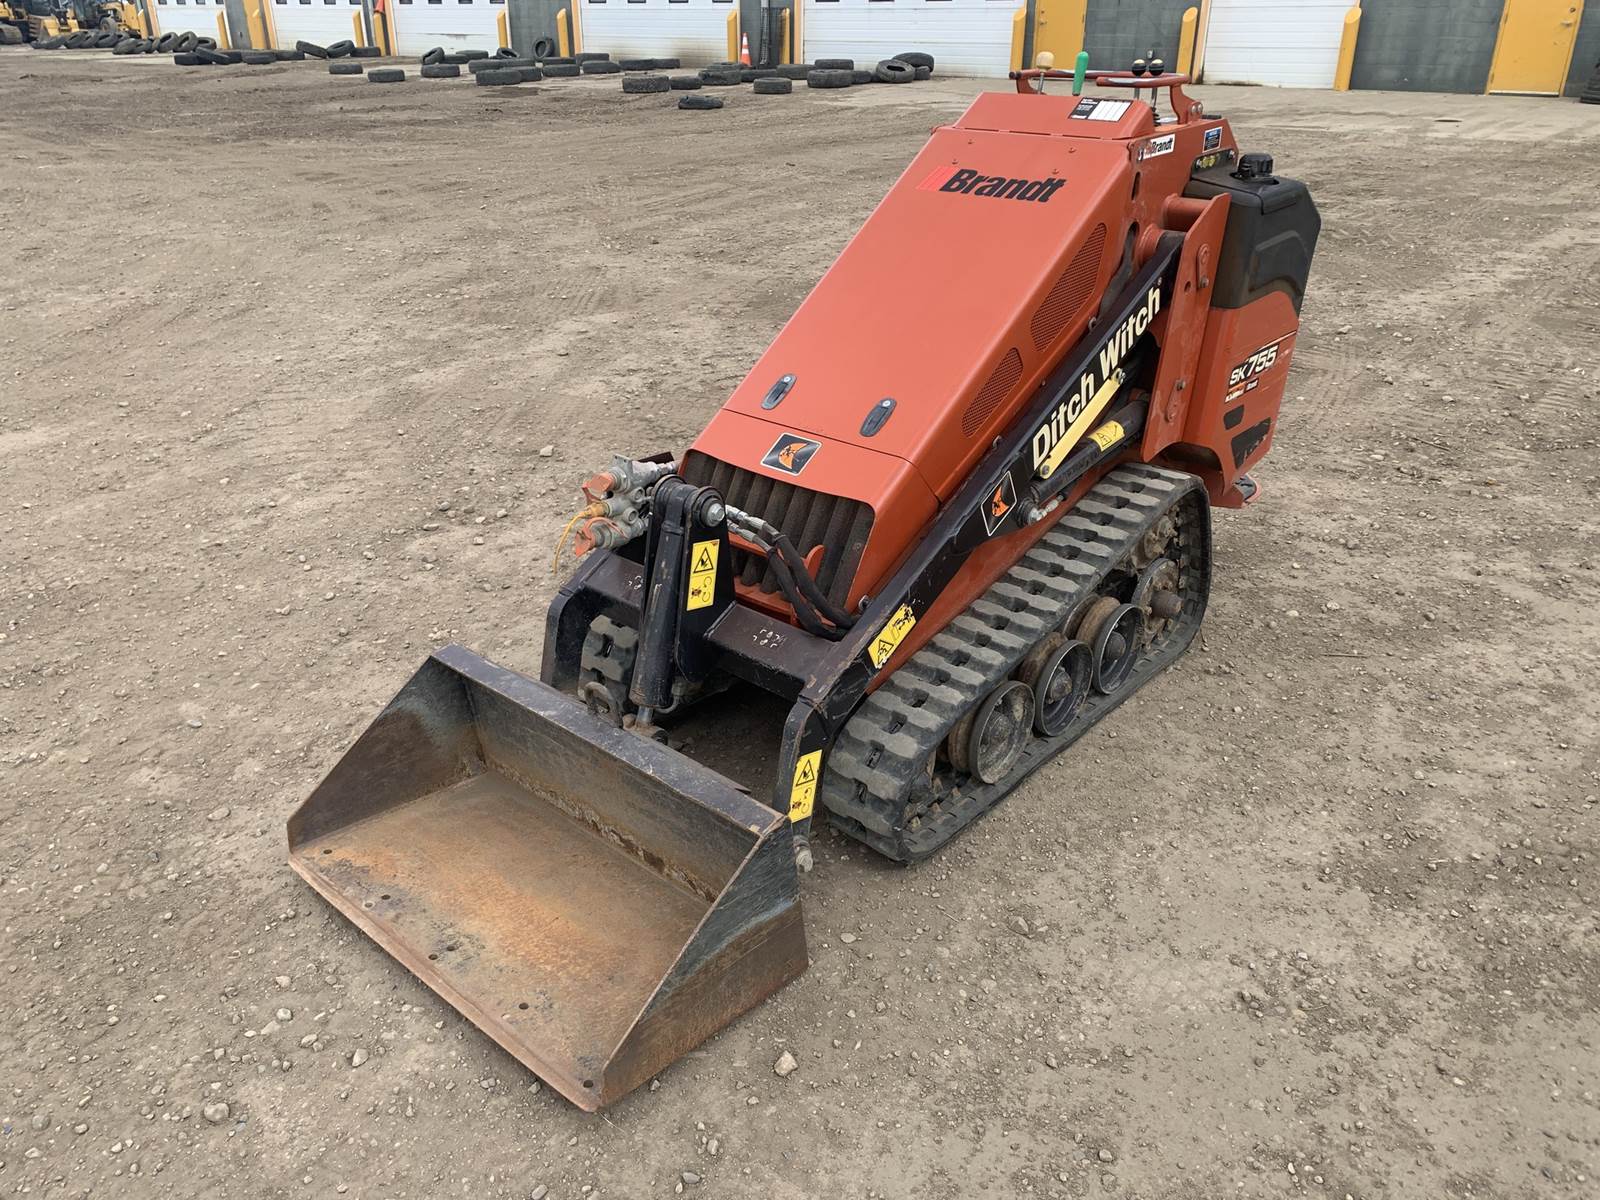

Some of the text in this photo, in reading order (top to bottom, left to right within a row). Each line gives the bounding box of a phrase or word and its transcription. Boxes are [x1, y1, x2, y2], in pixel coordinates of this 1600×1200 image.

[1150, 137, 1173, 154] Brandt
[939, 168, 1067, 203] Brandt
[1033, 373, 1095, 470] Ditch
[1100, 286, 1160, 379] Witch
